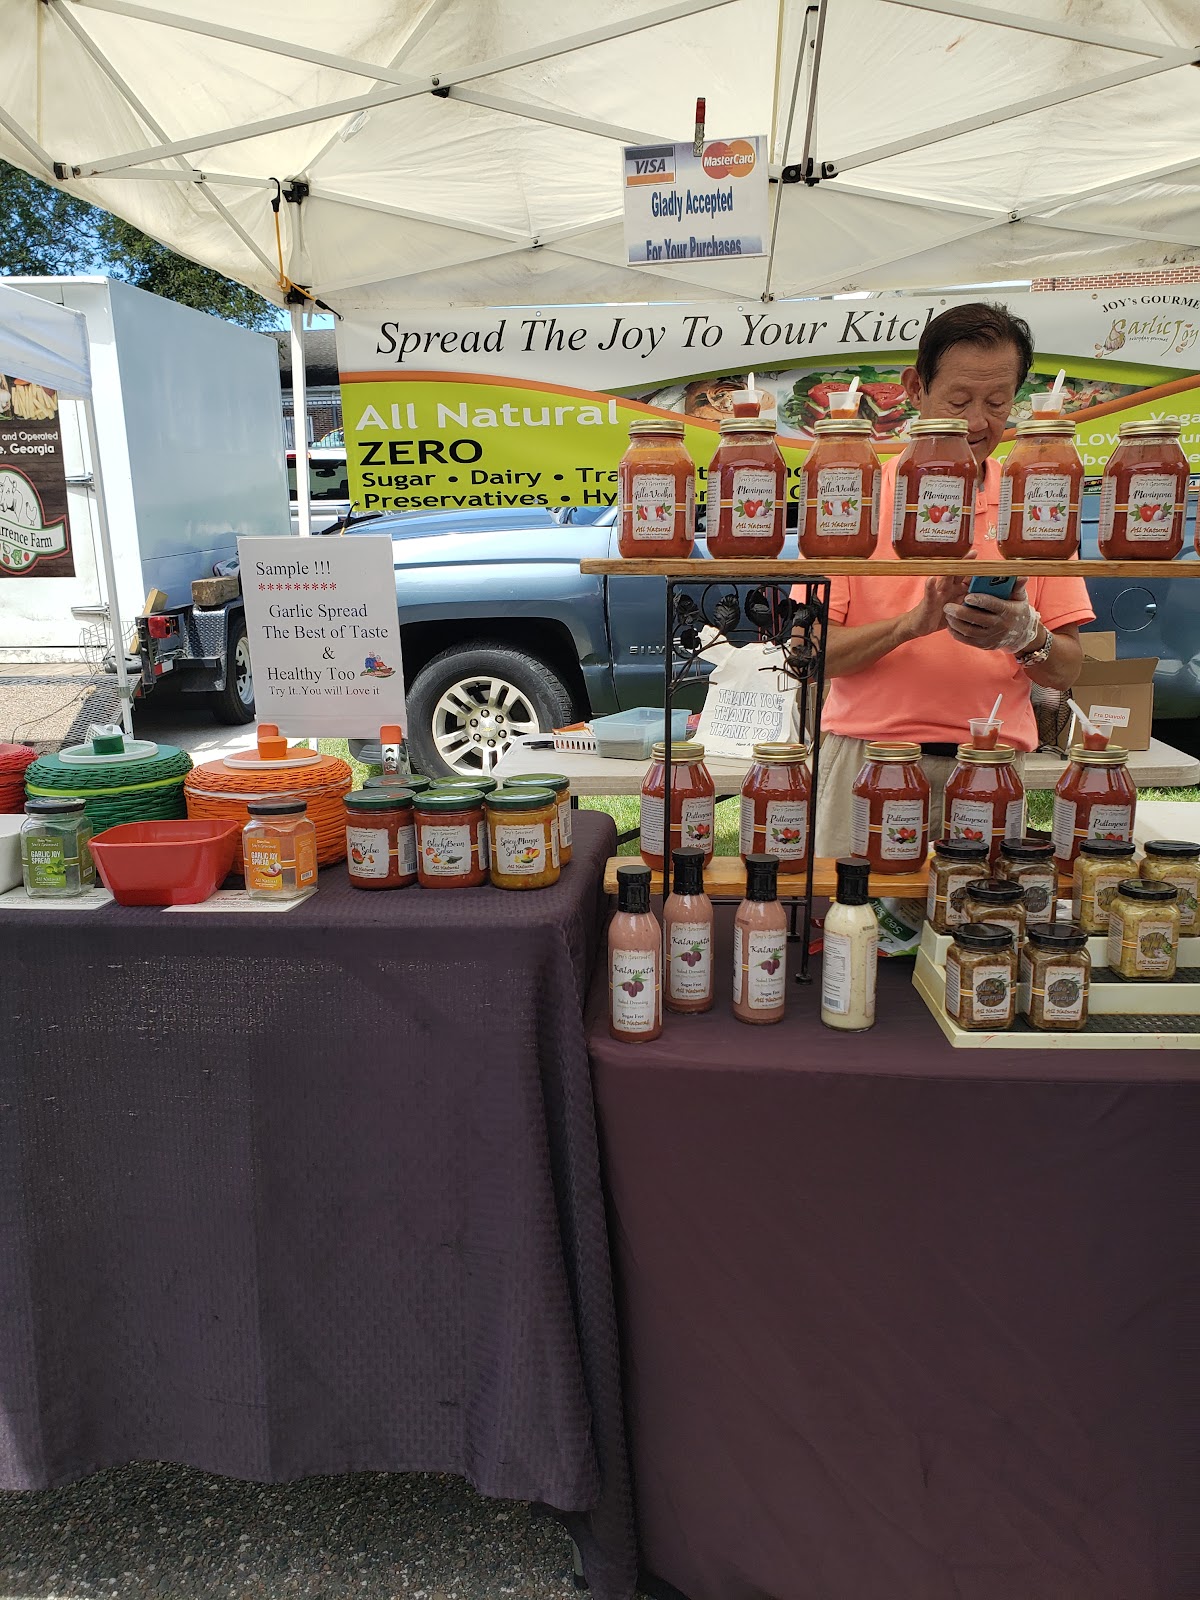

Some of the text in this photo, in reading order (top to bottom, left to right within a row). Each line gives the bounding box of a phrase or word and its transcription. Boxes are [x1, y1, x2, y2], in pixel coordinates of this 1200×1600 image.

[634, 158, 666, 175] VISA
[703, 153, 755, 168] MasterCard
[651, 186, 734, 222] Gladly Accepted
[646, 235, 742, 261] For Your Purchases
[1102, 295, 1200, 313] JOY's GOURME
[376, 308, 934, 363] Spread The Joy To Your Kitc
[1106, 316, 1199, 356] Garlic Joy
[355, 399, 620, 431] All Natural
[1150, 412, 1200, 427] Vega
[2, 431, 59, 442] and Operated
[10, 443, 55, 456] Georgia
[357, 439, 483, 466] ZERO
[362, 467, 618, 492] Sugar Dairy Tra
[364, 492, 549, 509] Preservatives
[0, 526, 53, 548] rrence Farm
[255, 561, 310, 578] Sample
[269, 603, 368, 621] Garlic Spread
[262, 624, 389, 639] The Best of Taste
[322, 646, 336, 660] &
[629, 646, 666, 654] SILV
[267, 667, 356, 683] Healthy Too
[269, 686, 286, 697] Try
[324, 685, 342, 695] will
[345, 686, 370, 695] Love
[372, 686, 380, 695] it
[719, 689, 757, 708] THANK
[714, 705, 782, 726] THANK YOU
[710, 722, 750, 740] THANK
[251, 852, 268, 860] GARLIC
[506, 848, 524, 856] Salsa
[31, 857, 51, 865] SPREAD
[884, 917, 903, 935] Sea
[672, 937, 710, 945] Kalamata
[613, 964, 654, 974] Kalamata
